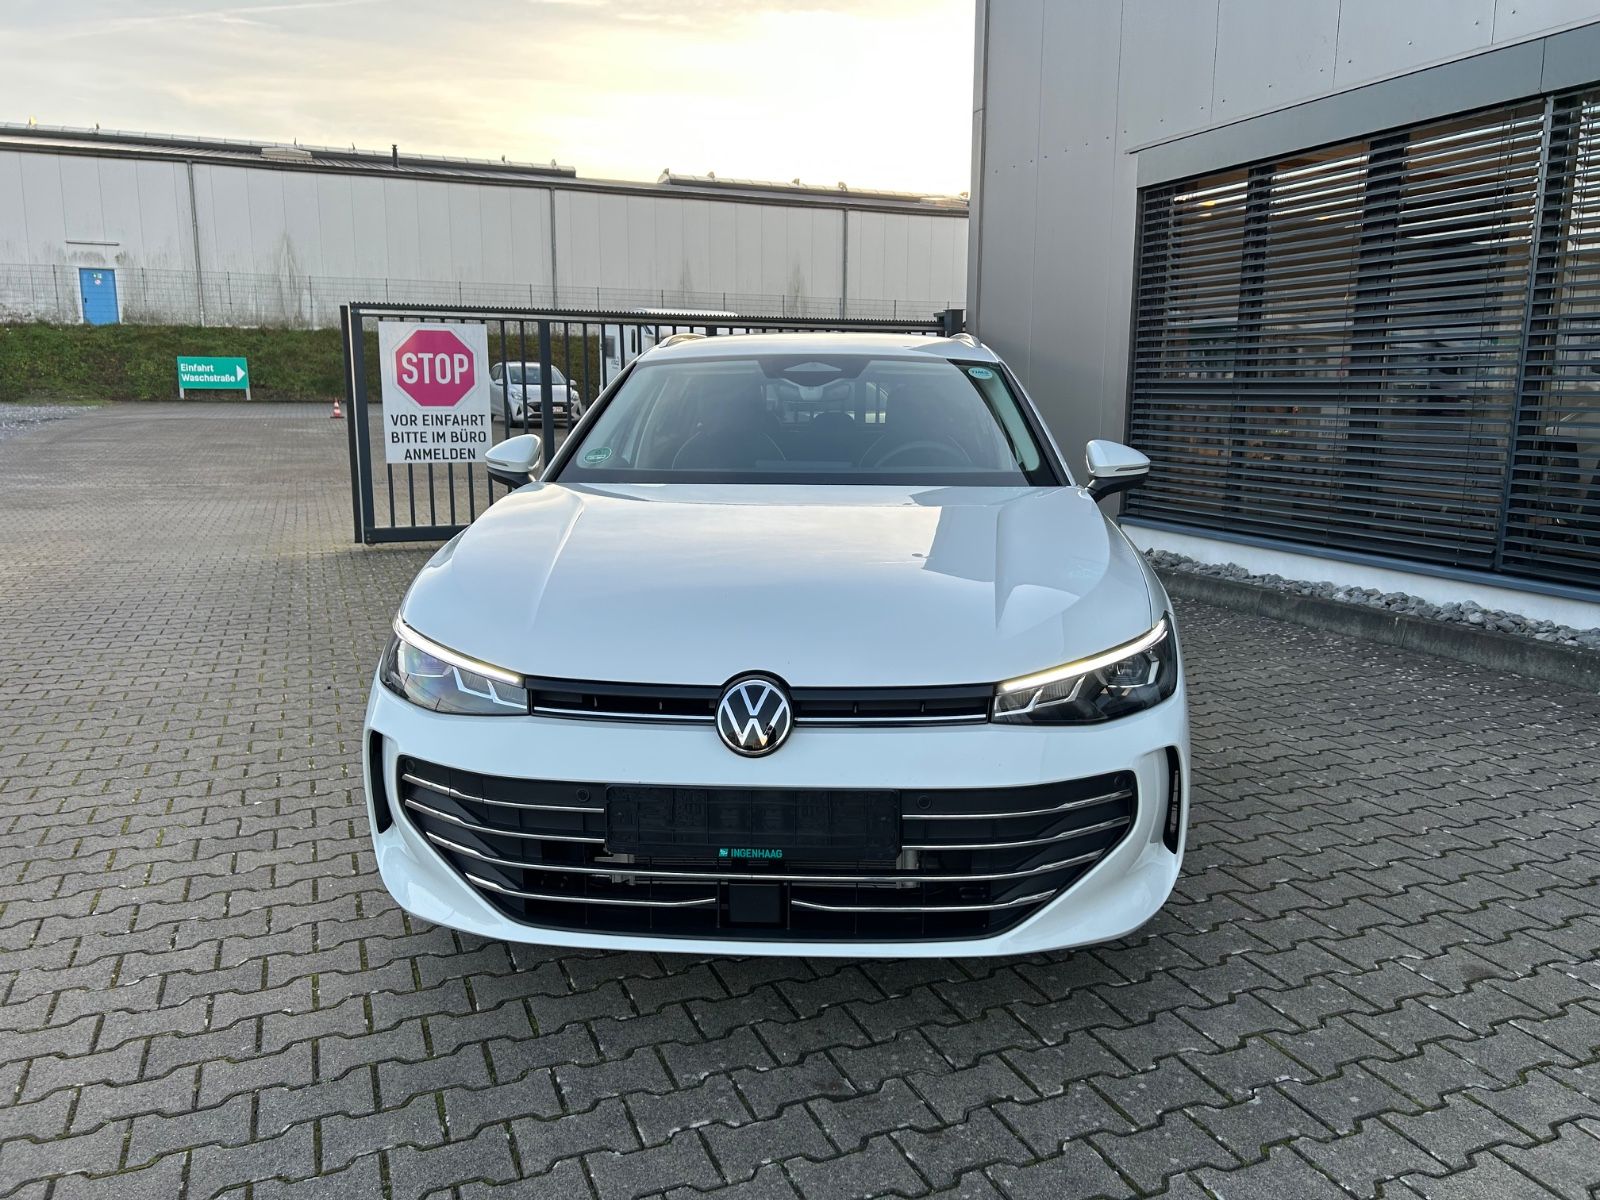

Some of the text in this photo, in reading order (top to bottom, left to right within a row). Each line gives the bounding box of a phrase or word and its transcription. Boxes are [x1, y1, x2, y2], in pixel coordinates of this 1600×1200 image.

[180, 363, 214, 372] Einfahrt
[401, 352, 469, 385] STOP
[181, 373, 236, 382] Waschstraße
[390, 414, 486, 427] VOR EINFAHRT
[391, 428, 487, 444] BITTE IM BÜRO
[404, 447, 476, 461] ANMELDEN
[720, 682, 789, 748] VW
[730, 848, 783, 858] INGENHAAG
